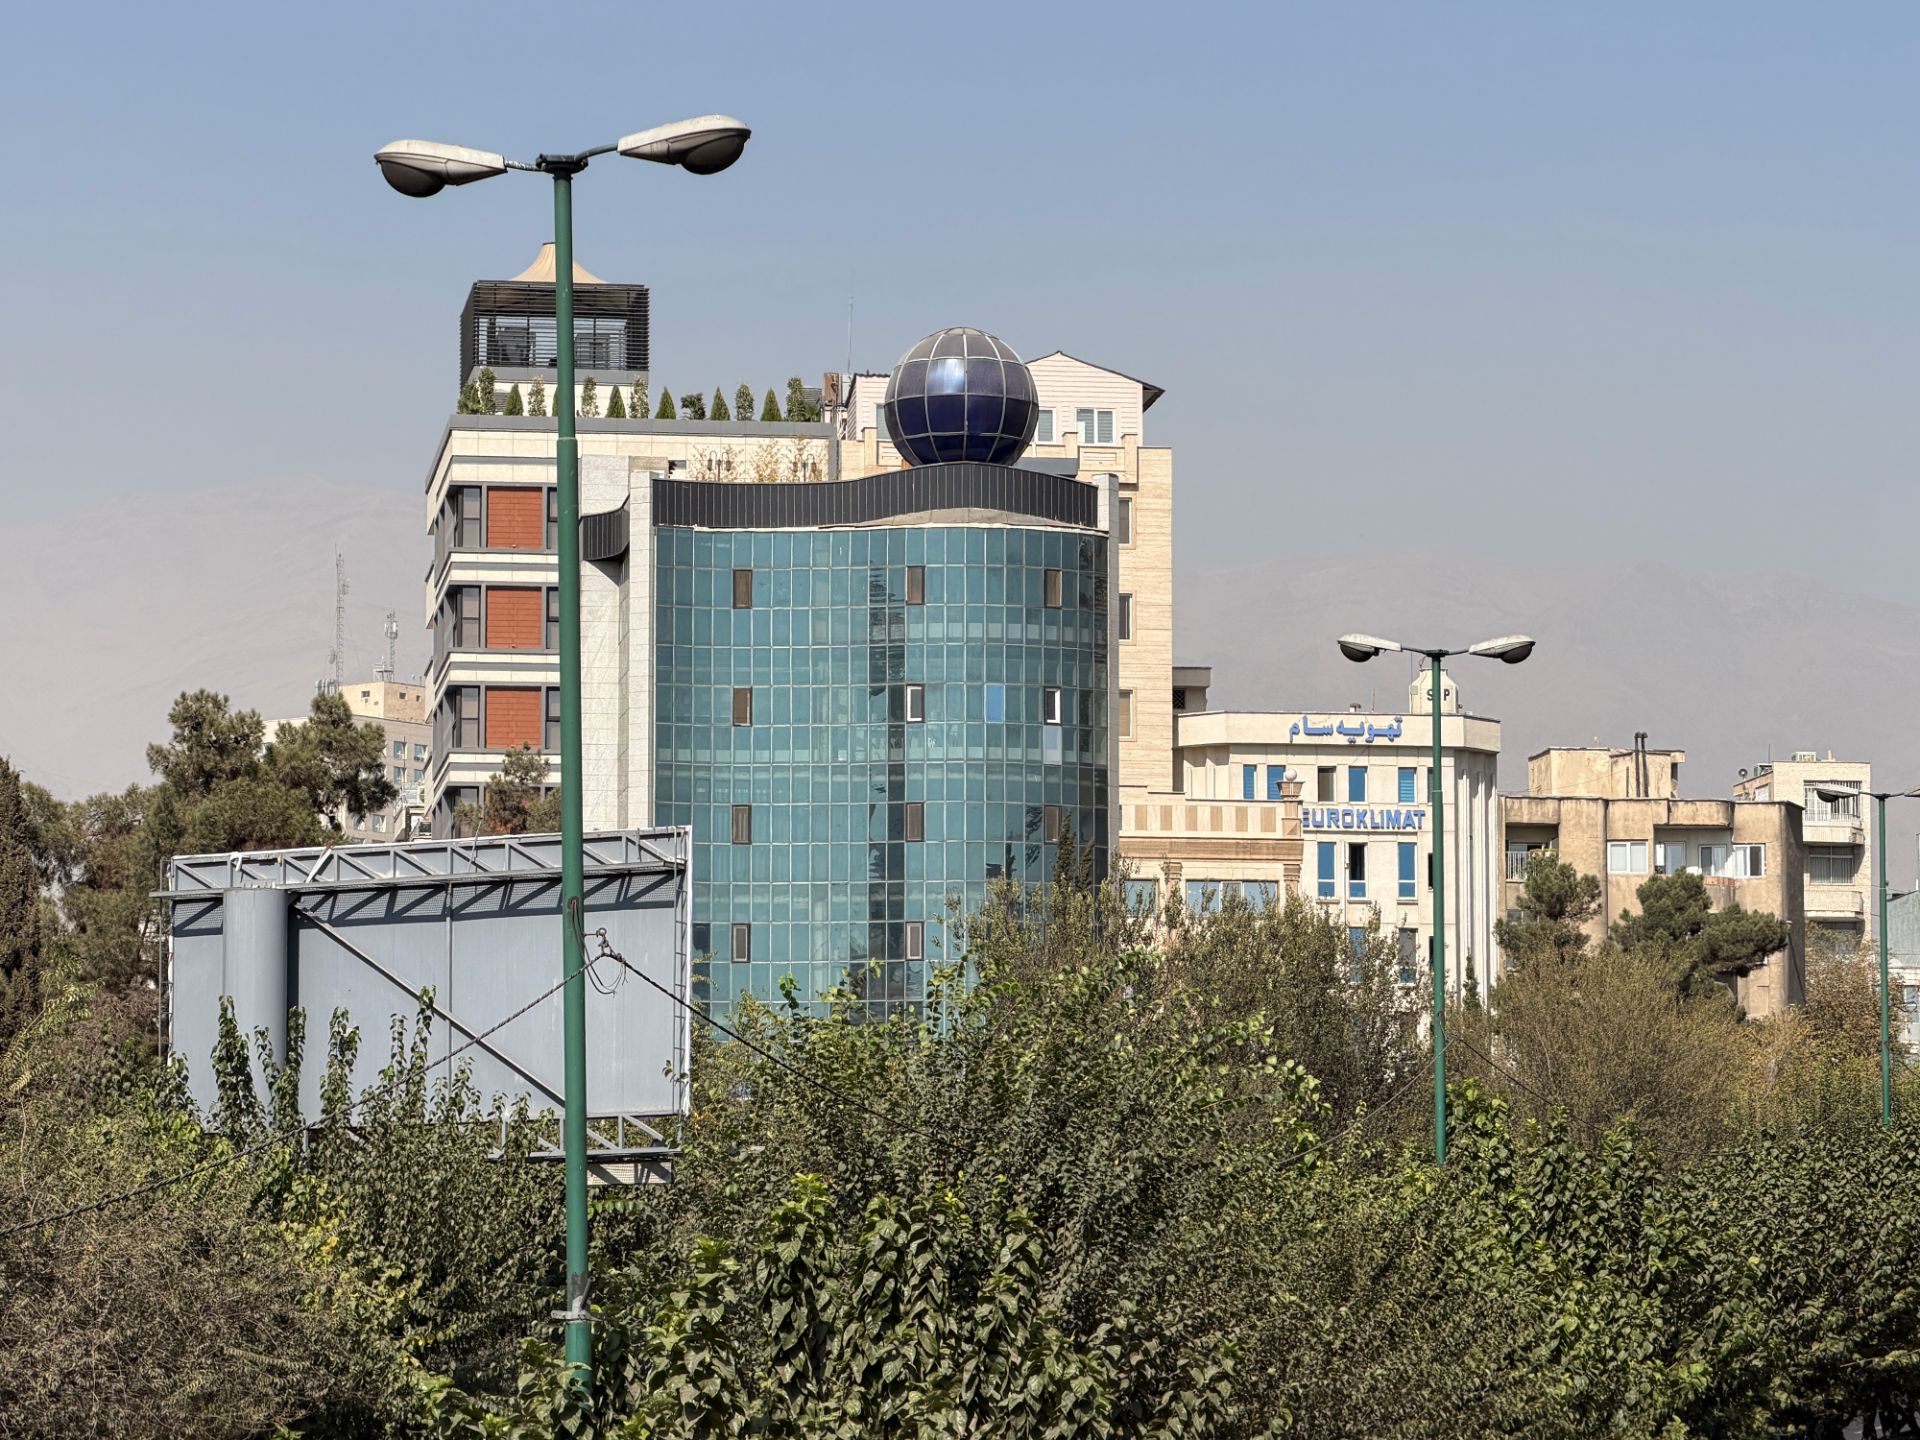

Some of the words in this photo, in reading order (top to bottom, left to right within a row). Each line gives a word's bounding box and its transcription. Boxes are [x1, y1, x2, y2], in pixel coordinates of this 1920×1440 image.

[1289, 715, 1334, 744] سام
[1336, 715, 1403, 743] تهویه
[1302, 808, 1426, 830] EUROKLIMAT
